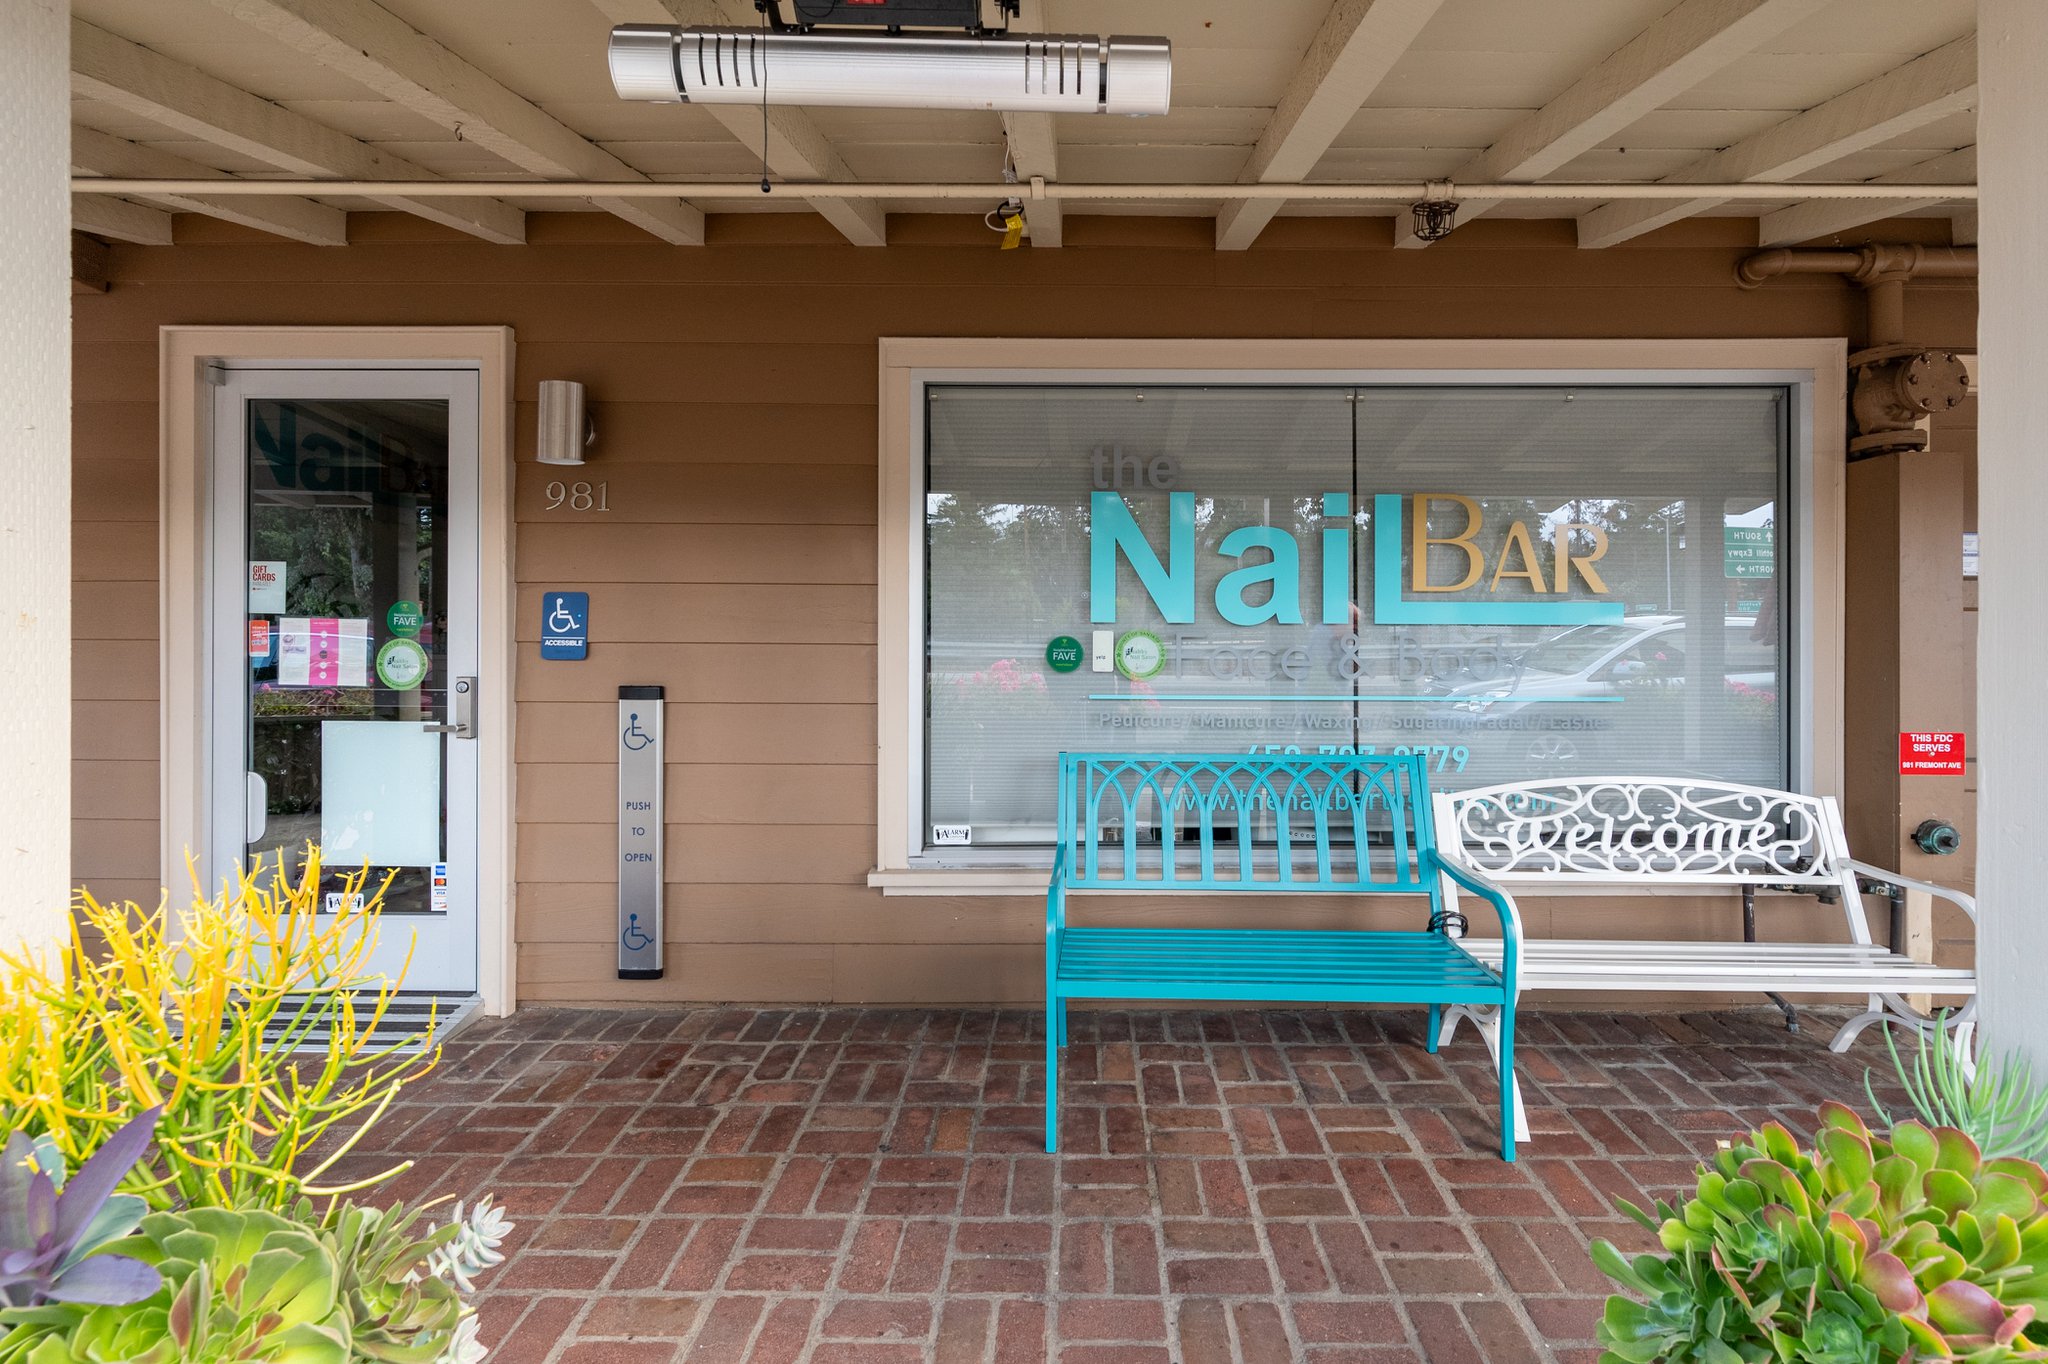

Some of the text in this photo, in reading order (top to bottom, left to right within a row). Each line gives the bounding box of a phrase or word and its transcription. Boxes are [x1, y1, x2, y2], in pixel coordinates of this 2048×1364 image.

[1089, 444, 1179, 490] the
[545, 481, 610, 511] 981
[252, 565, 268, 574] GIFT
[252, 573, 276, 581] CARDS
[393, 616, 417, 626] FAVE
[544, 639, 583, 647] ACCESSIBLE
[1053, 652, 1077, 661] FAVE
[1175, 630, 1528, 695] Face & Body
[1100, 713, 1180, 728] Pedicure
[1200, 714, 1286, 729] Manicure
[1304, 713, 1372, 732] Waxing
[1911, 733, 1953, 742] THIS FDC
[1913, 743, 1951, 752] SERVES
[1902, 761, 1962, 769] 981 FREMONT AVE
[626, 801, 651, 811] PUSH
[632, 826, 645, 836] TO
[624, 852, 652, 862] OPEN
